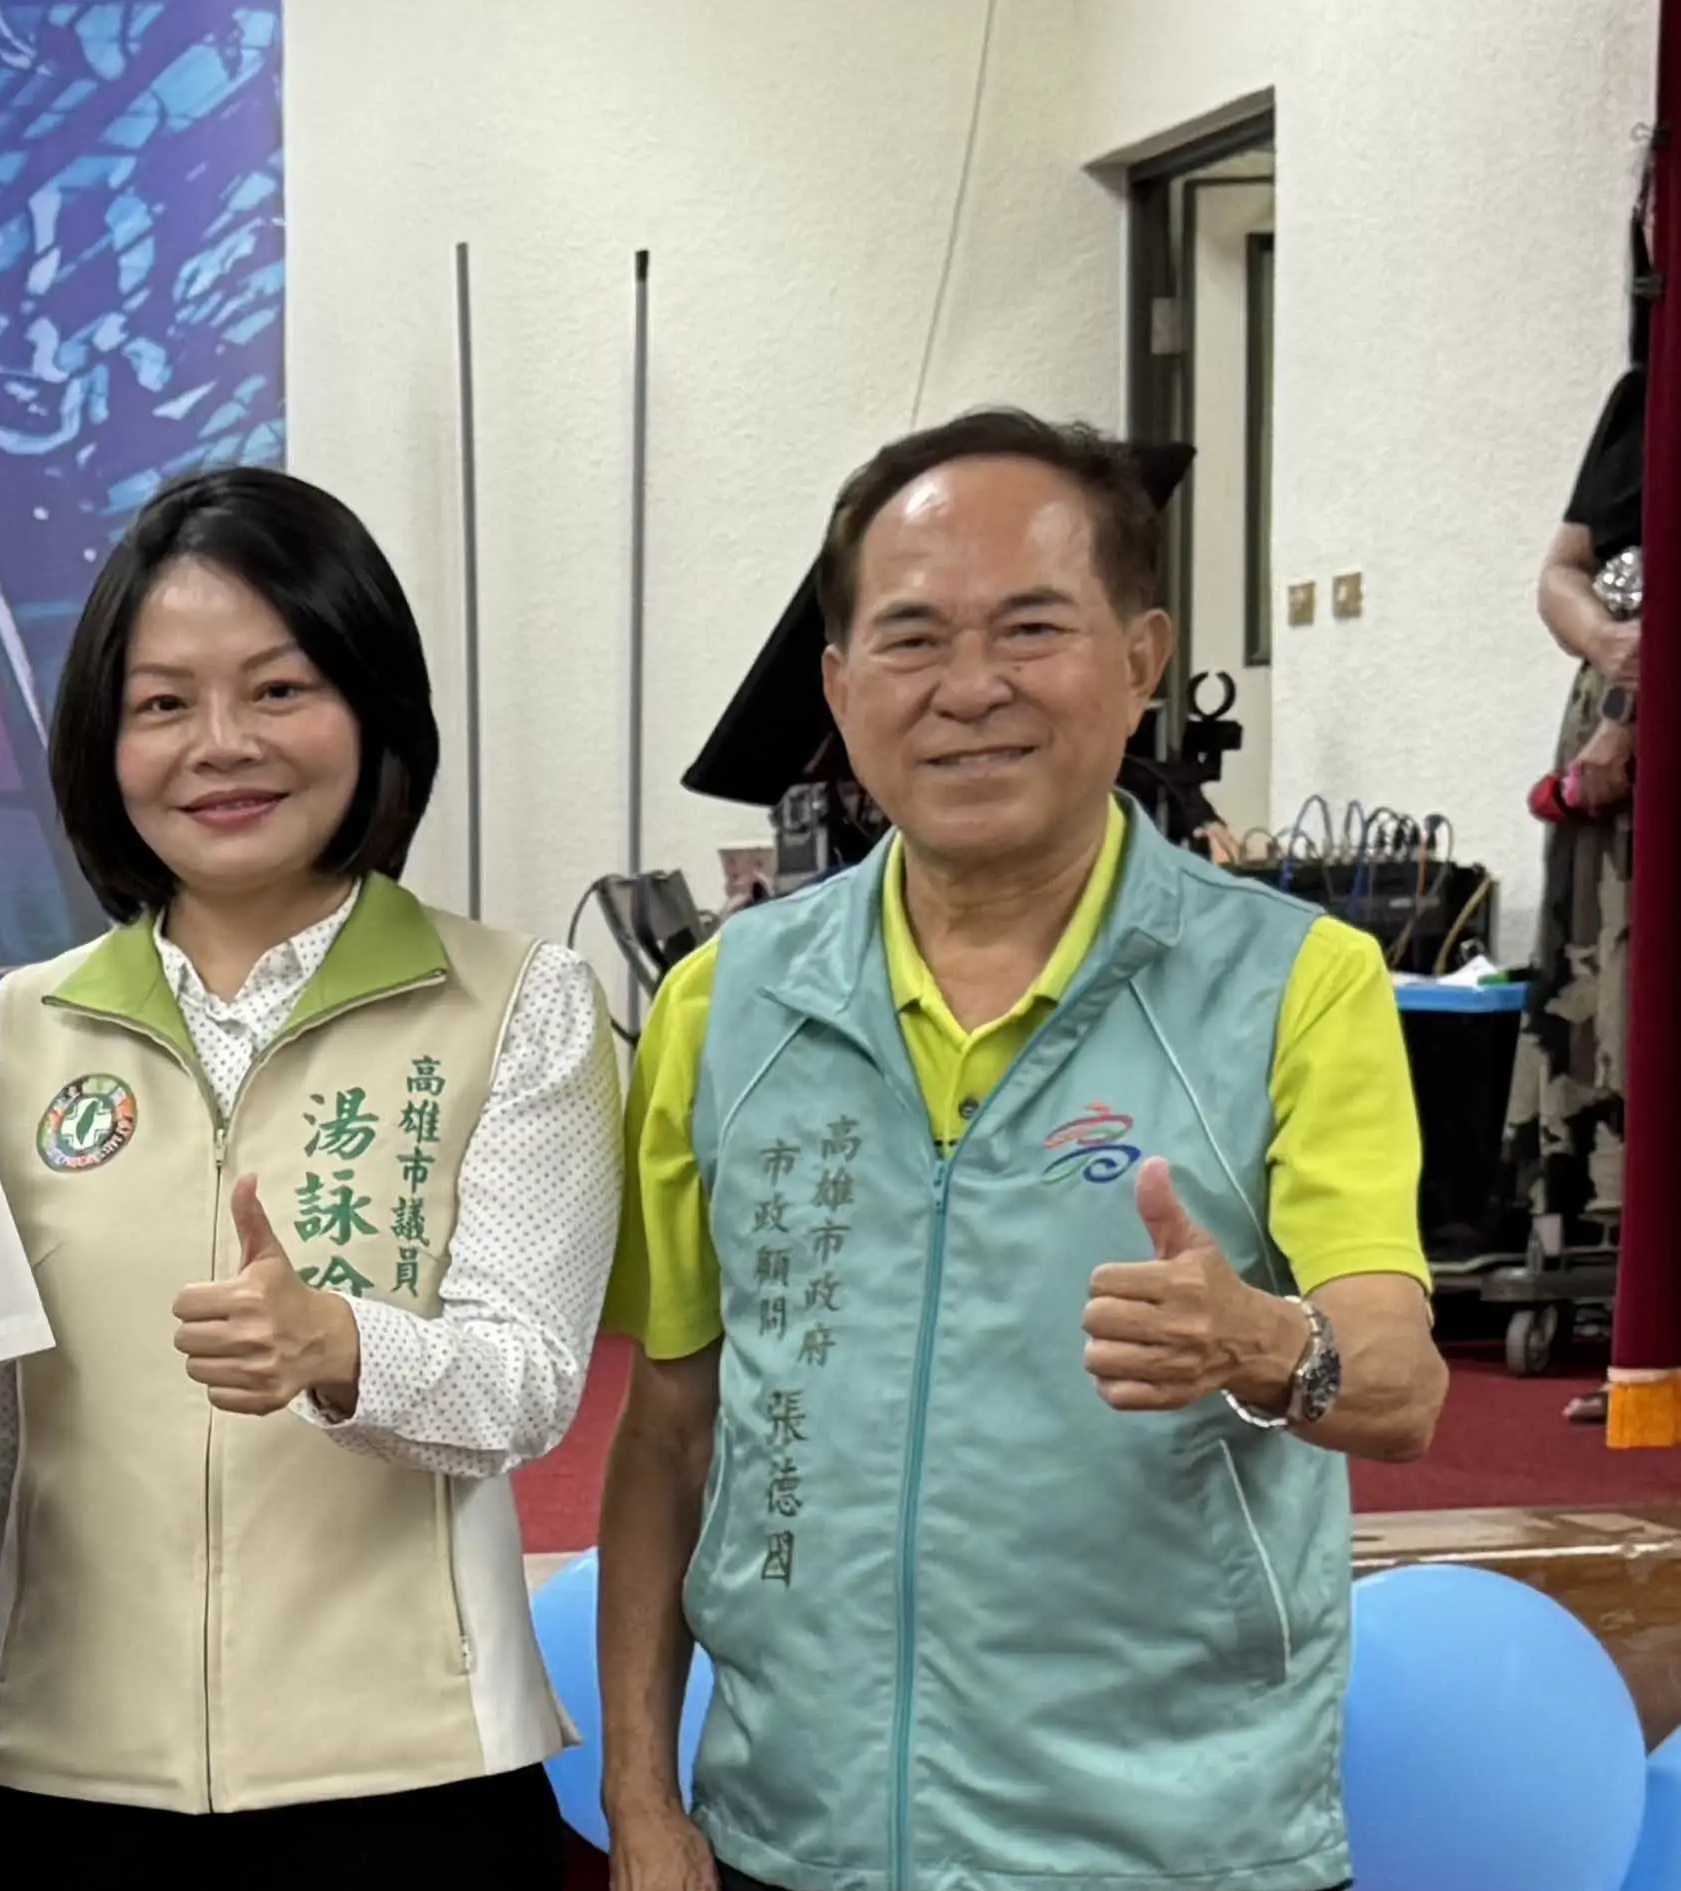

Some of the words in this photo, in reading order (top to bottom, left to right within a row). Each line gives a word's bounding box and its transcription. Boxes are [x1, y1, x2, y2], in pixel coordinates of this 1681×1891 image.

[389, 1054, 446, 1298] 高雄市議員
[752, 1138, 802, 1343] 市政顧問
[796, 1114, 863, 1368] 高雄市政府
